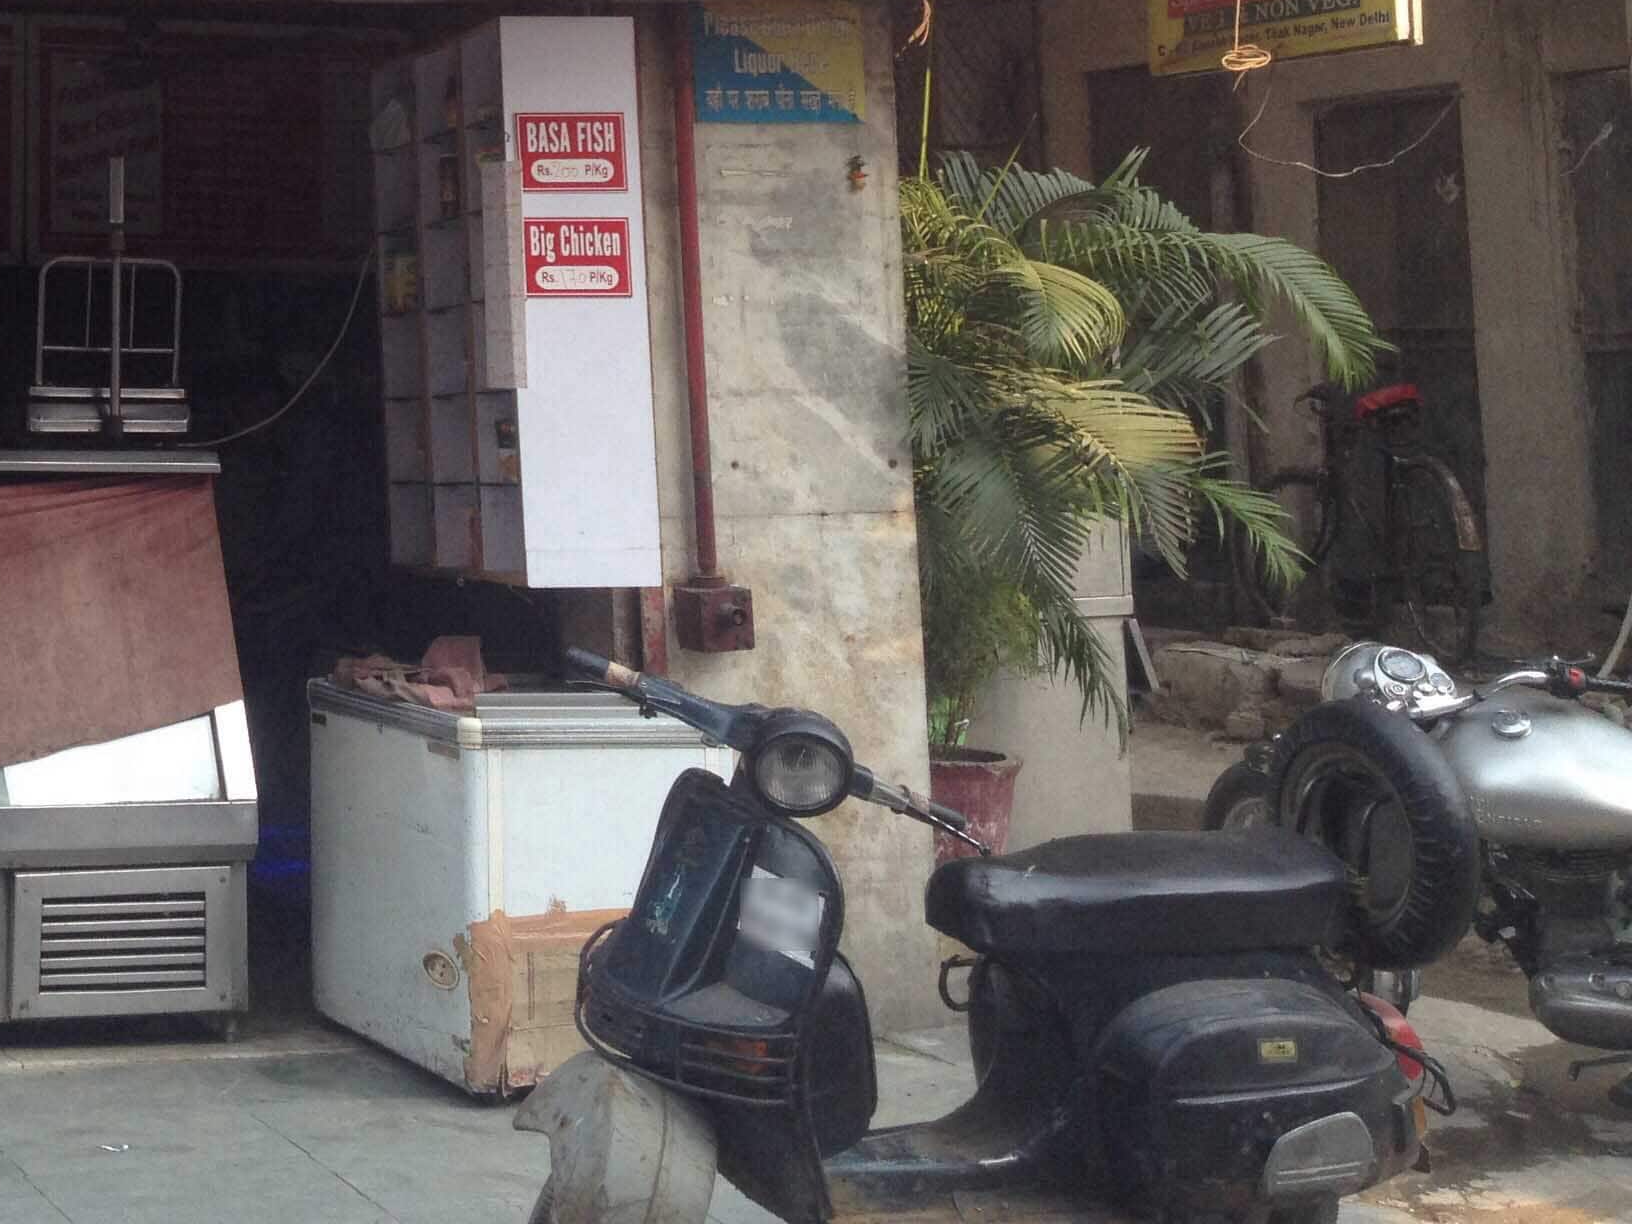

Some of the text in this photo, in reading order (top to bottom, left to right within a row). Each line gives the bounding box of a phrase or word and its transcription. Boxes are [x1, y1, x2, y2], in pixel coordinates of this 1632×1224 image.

[1331, 15, 1356, 30] New
[1359, 11, 1391, 26] Delhi
[734, 47, 785, 77] Liquor
[525, 121, 616, 153] BASA FISH
[536, 164, 553, 176] Rs.
[529, 224, 621, 263] Big Chicken
